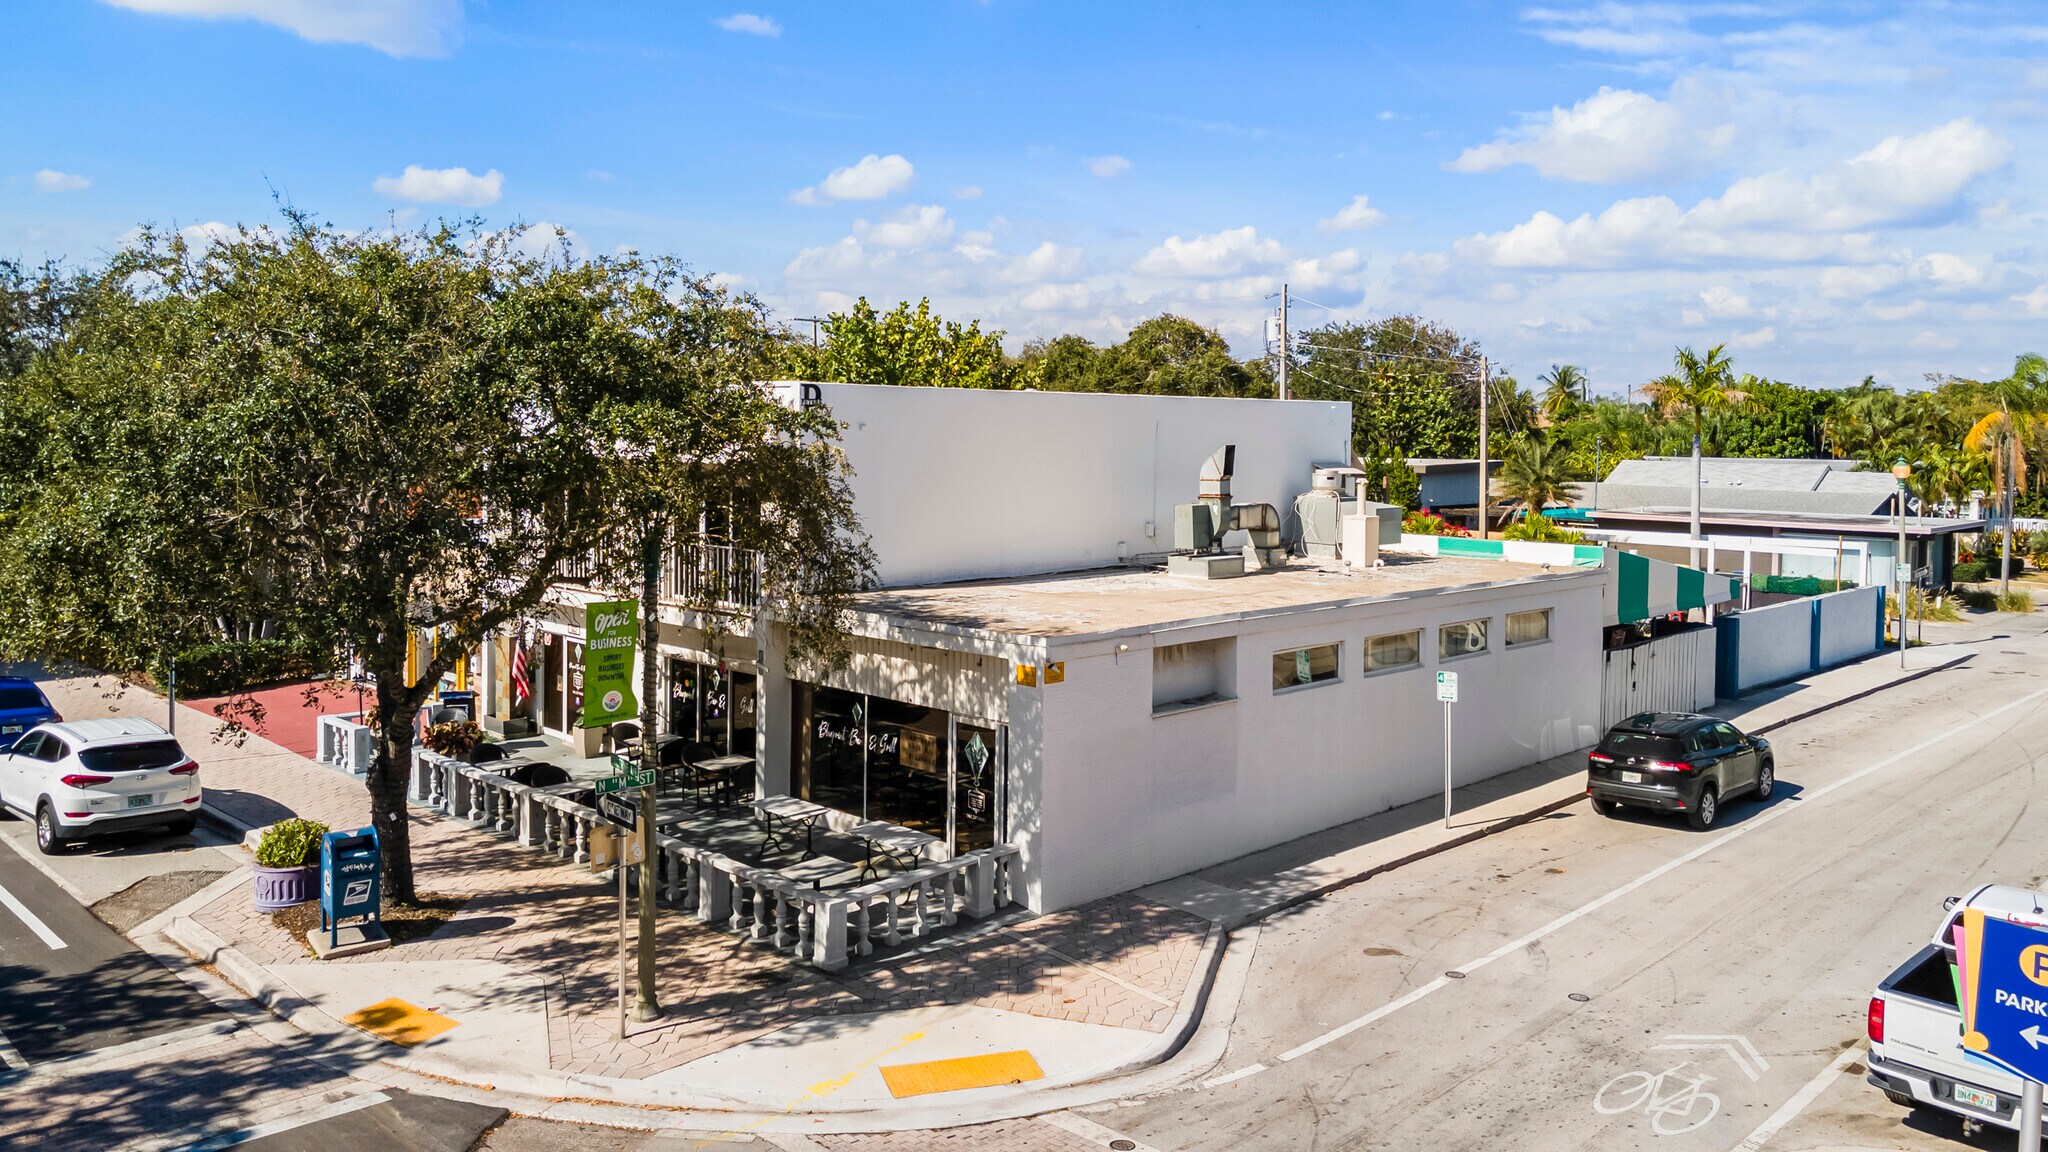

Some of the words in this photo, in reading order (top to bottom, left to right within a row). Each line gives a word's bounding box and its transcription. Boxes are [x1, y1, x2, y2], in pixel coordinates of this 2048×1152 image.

[590, 636, 632, 650] BUSINESS
[868, 734, 877, 752] &
[598, 781, 606, 793] N
[640, 772, 652, 785] ST
[606, 801, 620, 817] ONE
[620, 807, 634, 823] WAY
